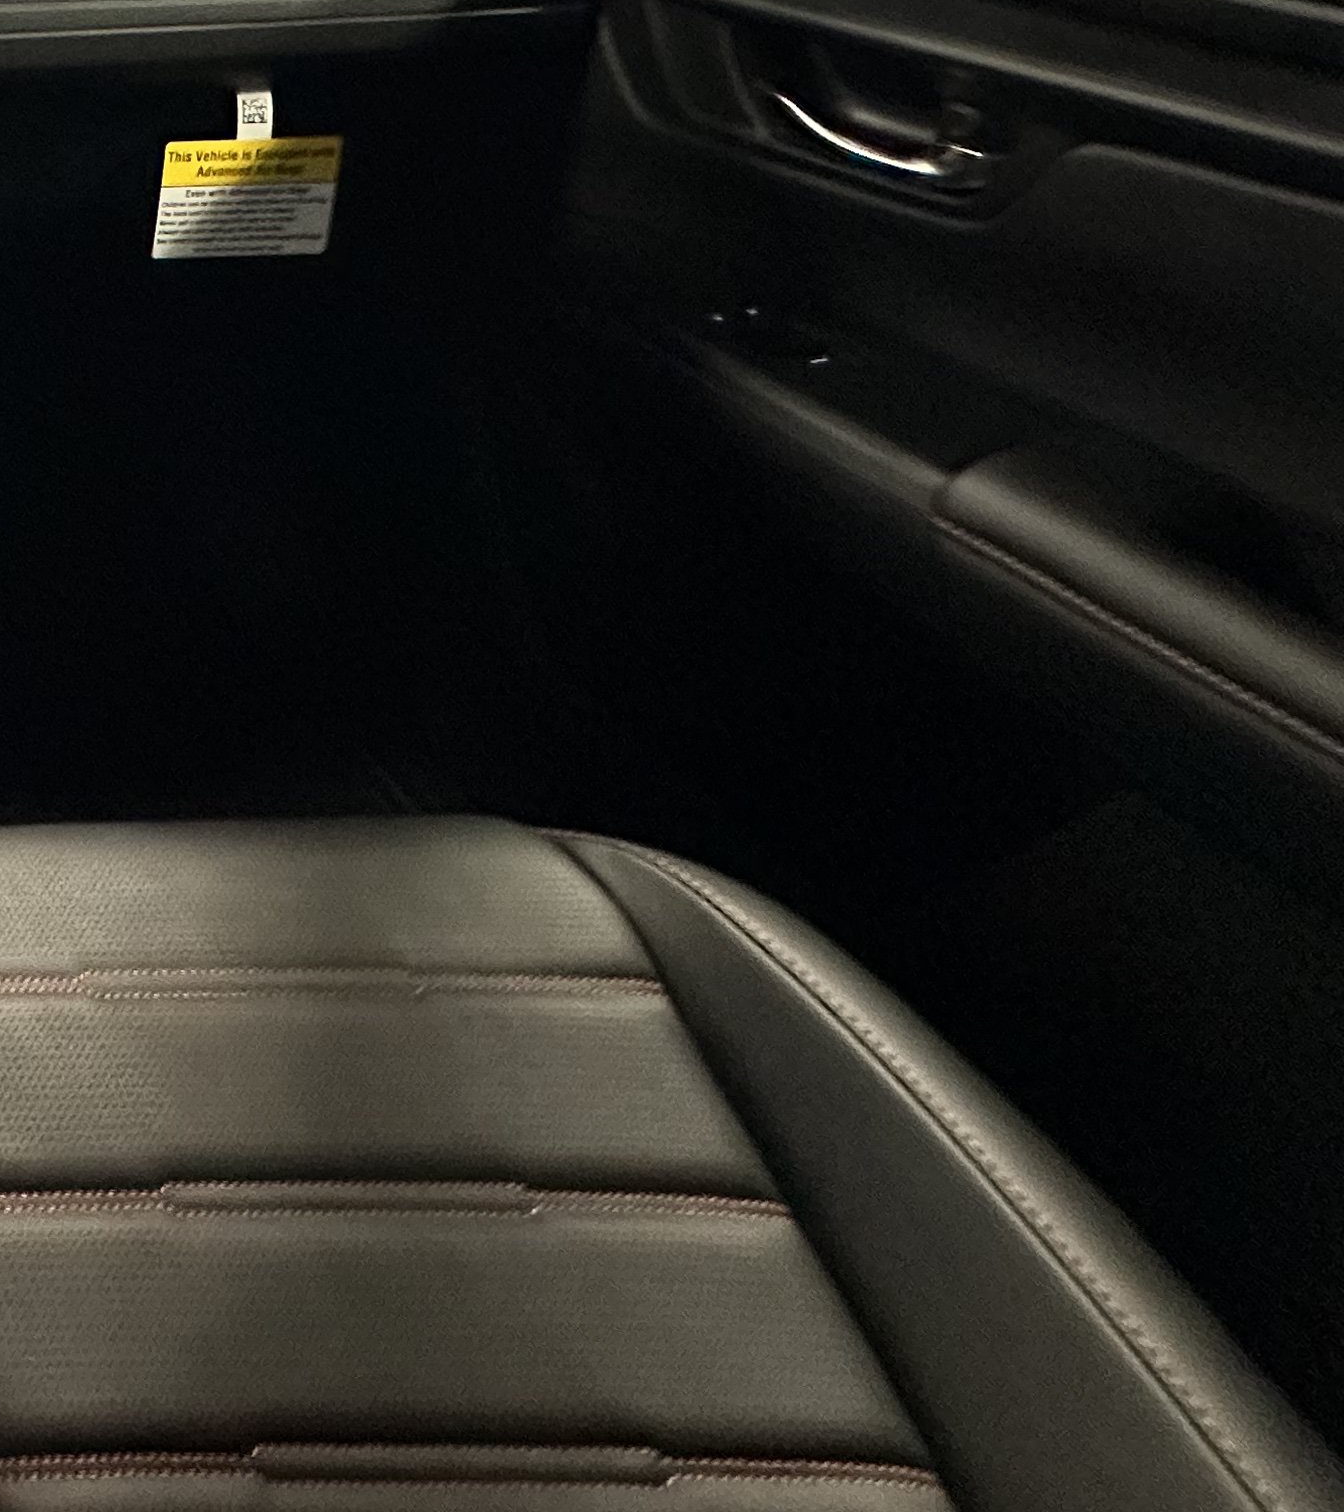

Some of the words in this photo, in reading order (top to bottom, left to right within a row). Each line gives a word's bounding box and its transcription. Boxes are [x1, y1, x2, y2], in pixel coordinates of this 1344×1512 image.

[168, 151, 192, 163] This
[196, 150, 238, 162] Vehicle
[242, 150, 252, 160] is
